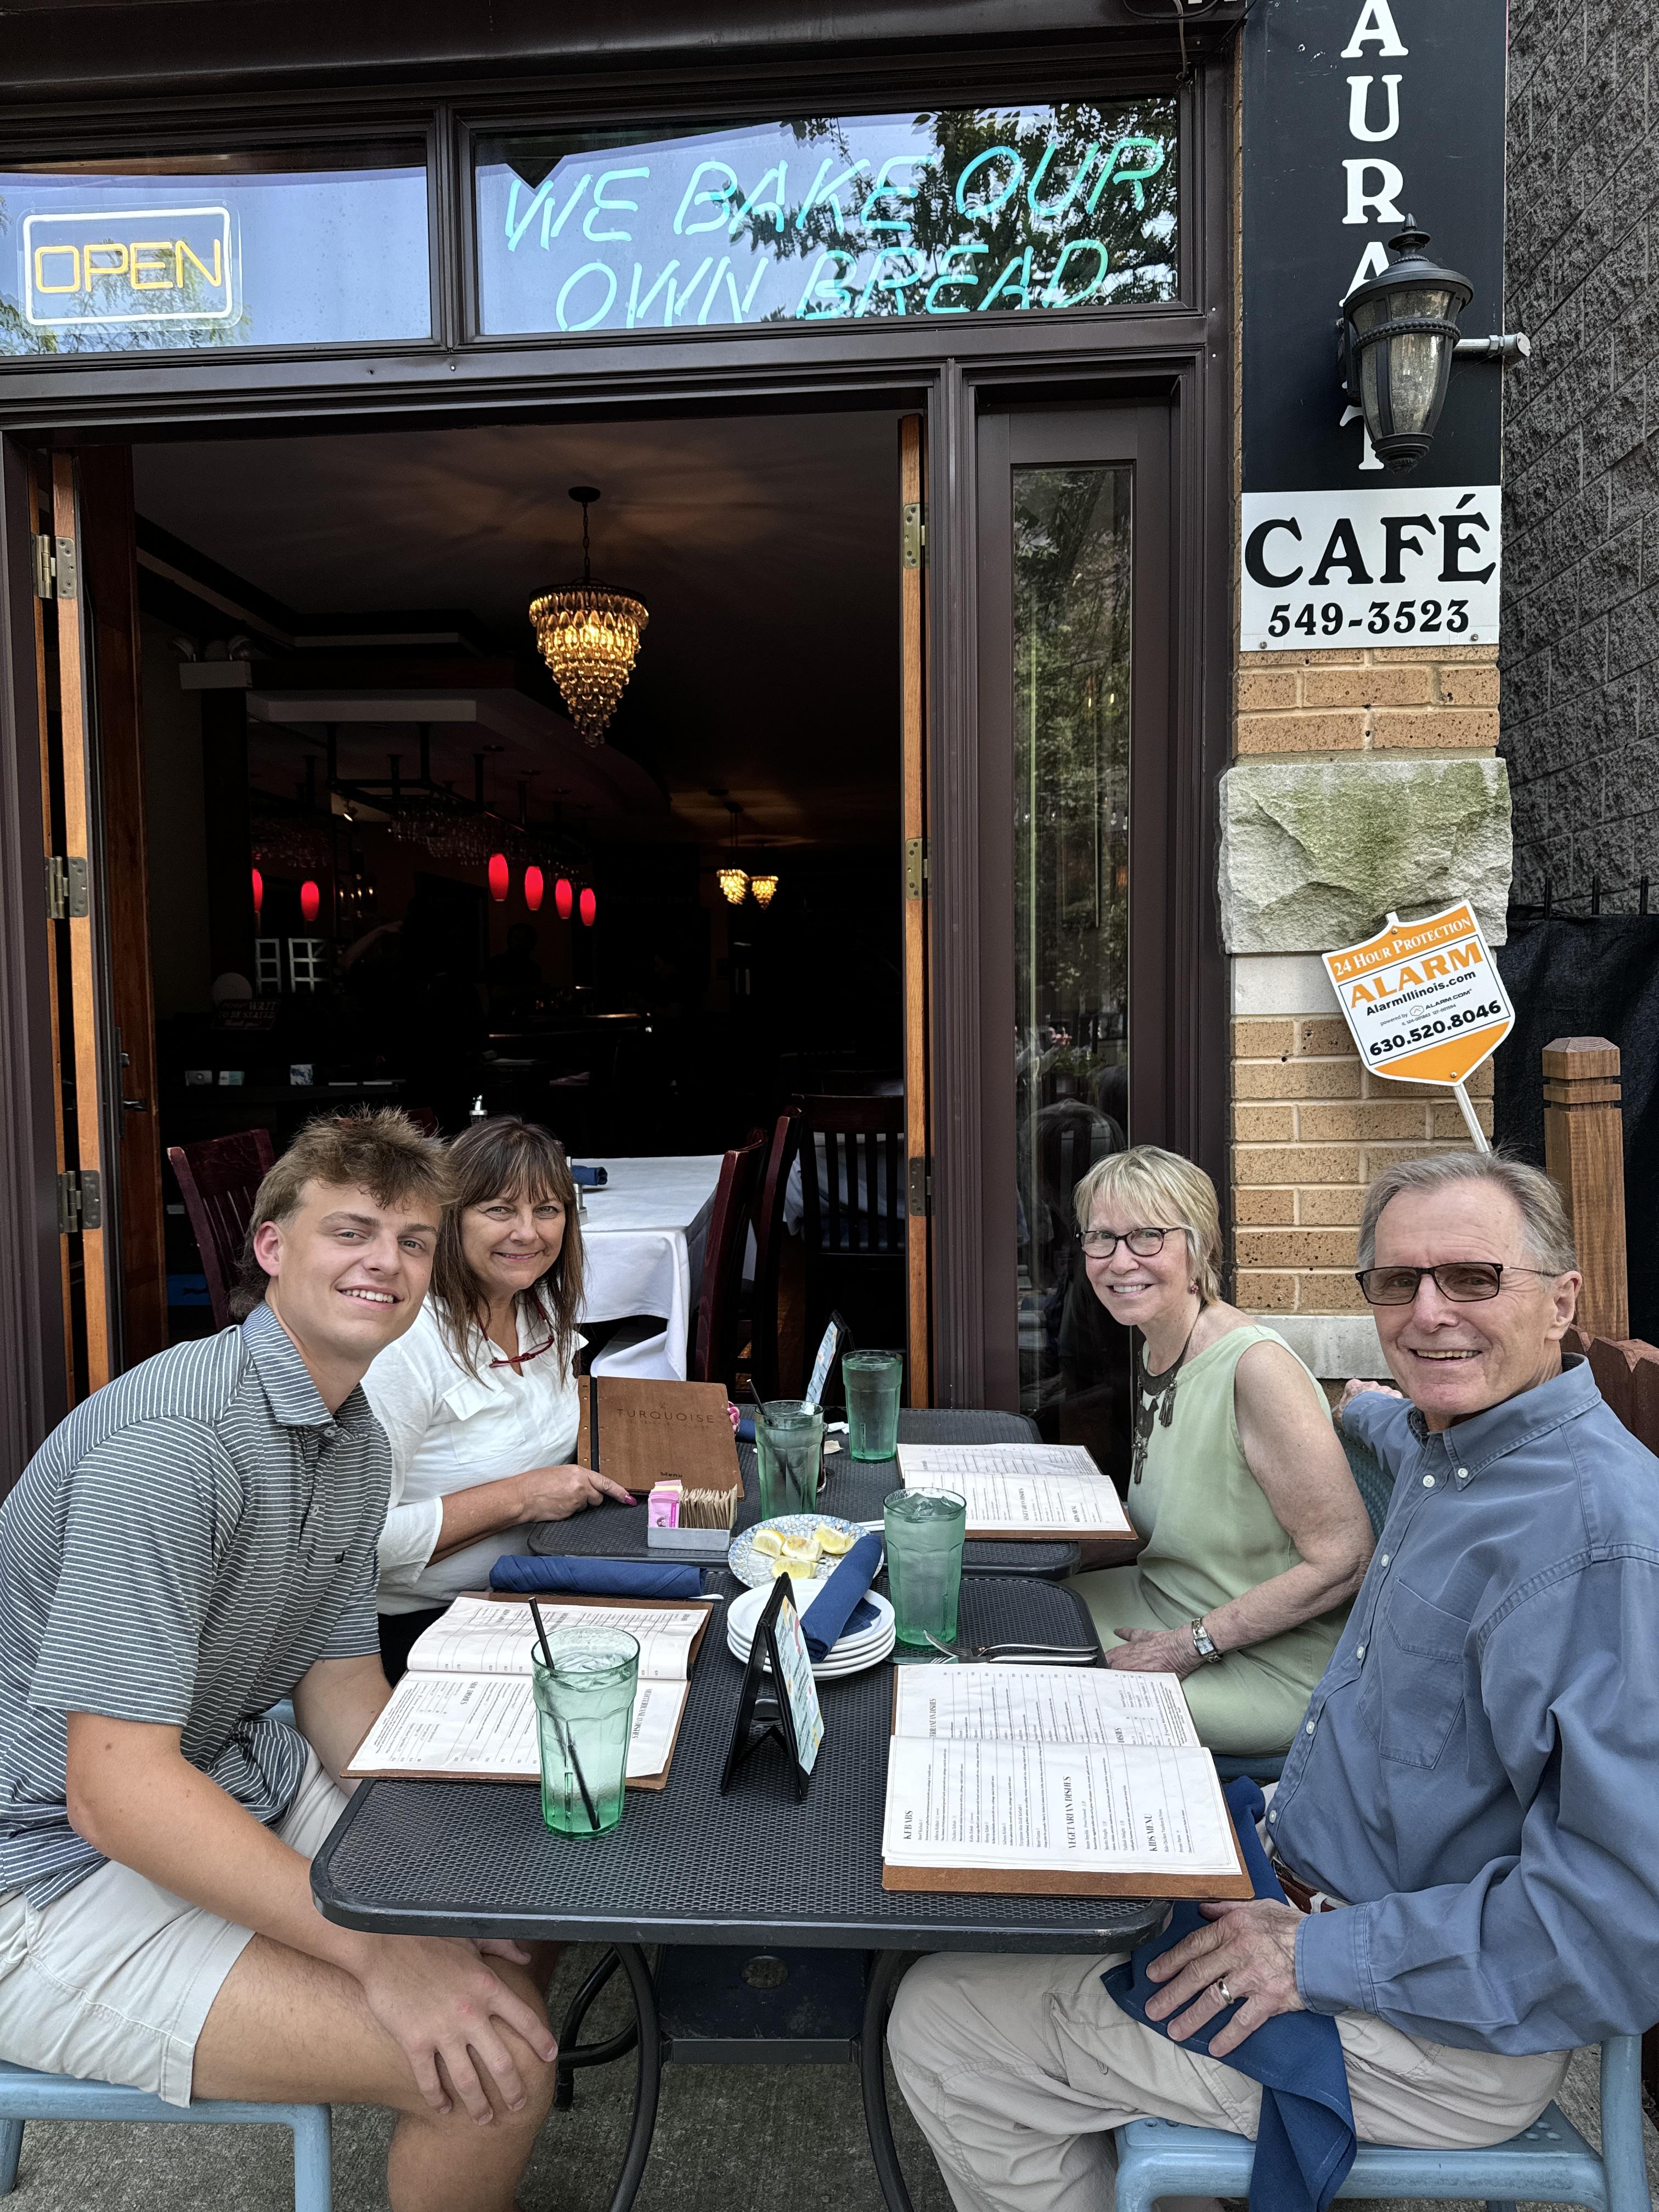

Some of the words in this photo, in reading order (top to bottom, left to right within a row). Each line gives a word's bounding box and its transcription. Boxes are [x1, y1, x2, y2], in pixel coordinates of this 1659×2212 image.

[505, 167, 650, 251] WE
[673, 155, 935, 235] BAKE
[956, 137, 1163, 219] OUR
[35, 239, 221, 293] OPEN
[556, 256, 769, 331] OWN
[795, 239, 1108, 320] BREAD
[1245, 494, 1496, 588] CAFÉ
[1268, 600, 1469, 637] 549-3523
[1334, 958, 1352, 976] 24
[1351, 941, 1483, 1008] ALARM
[1367, 971, 1476, 1016] AlarmIllinois.com
[1370, 1000, 1501, 1056] 630.520.8046
[1380, 1015, 1401, 1026] powered
[617, 1408, 715, 1423] TURQUOISE
[1063, 1776, 1073, 1801] DISHES
[903, 1810, 913, 1839] KEBABS
[1064, 1803, 1076, 1848] VEGETARIAN
[1143, 1813, 1154, 1834] MENU
[1147, 1836, 1158, 1852] KIDS
